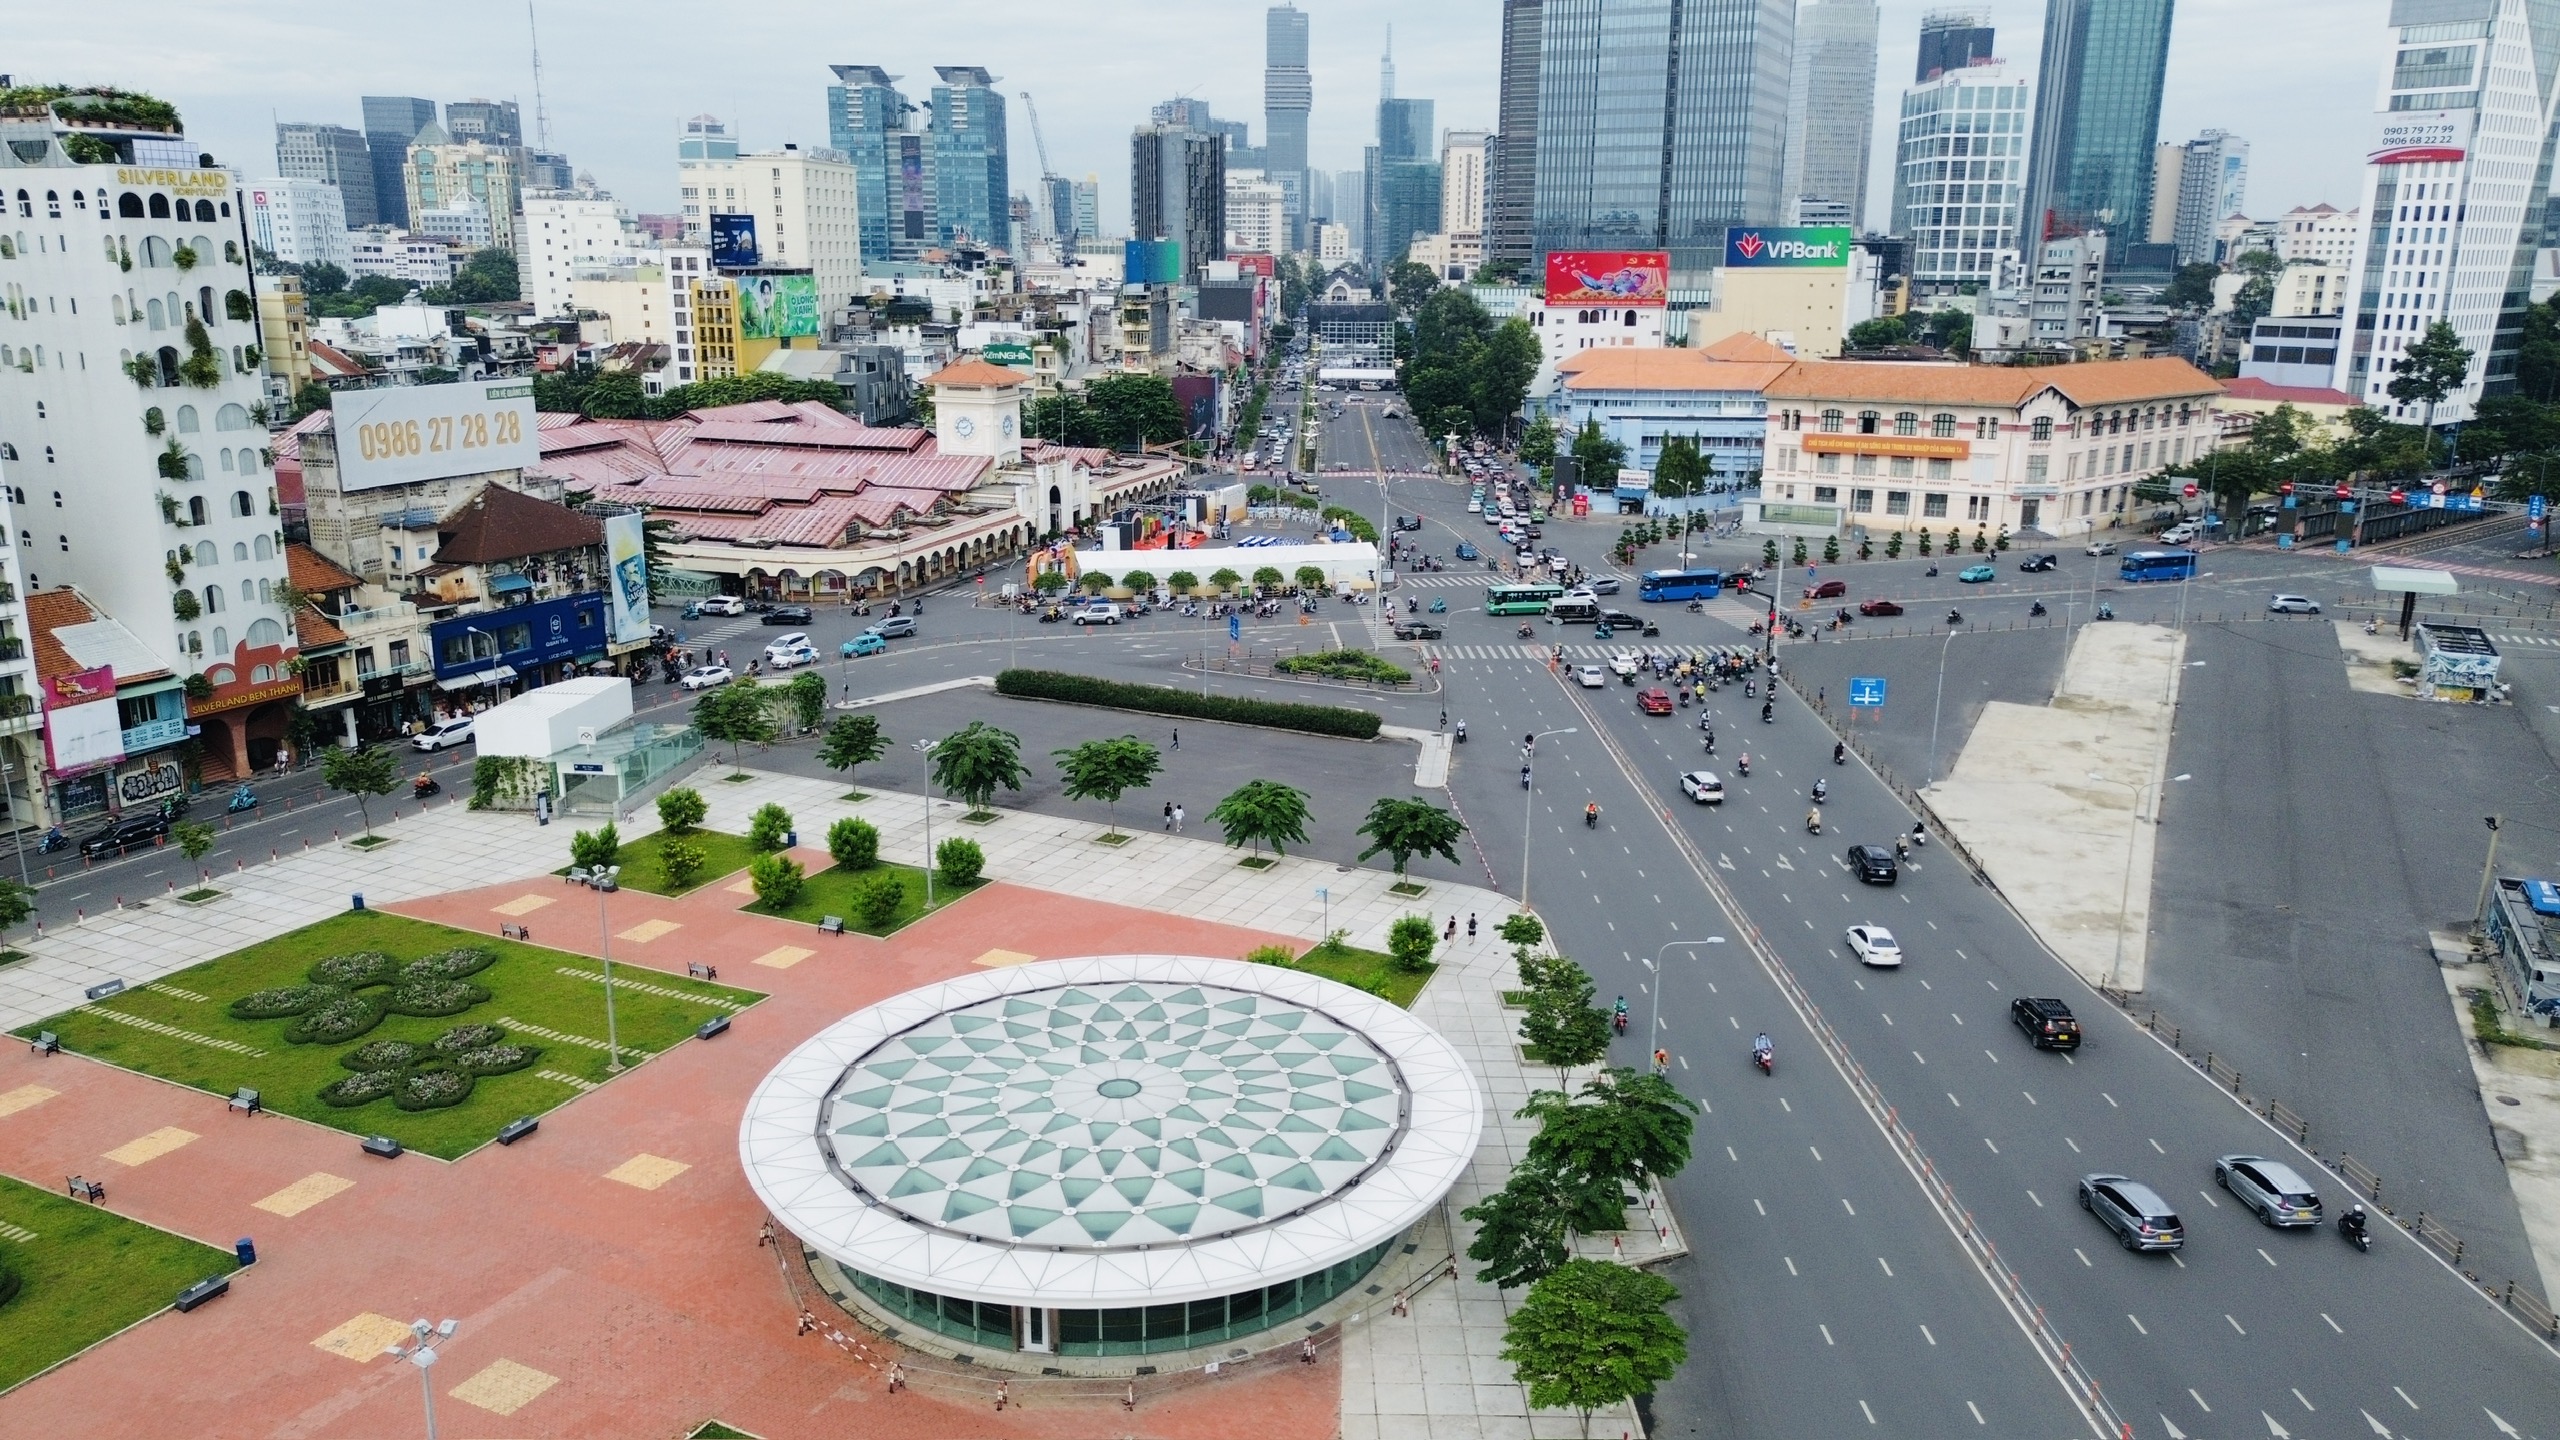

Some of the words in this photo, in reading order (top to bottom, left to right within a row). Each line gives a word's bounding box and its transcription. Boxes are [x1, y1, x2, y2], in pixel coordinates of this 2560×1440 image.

[2384, 127, 2409, 135] 0903
[2411, 126, 2424, 134] 79
[2426, 125, 2439, 134] 77
[2441, 125, 2454, 133] 99
[2382, 137, 2407, 145] 0906
[2409, 136, 2422, 144] 68
[2424, 136, 2437, 144] 22
[2439, 135, 2452, 143] 22
[117, 168, 227, 187] SILVERLAND
[173, 187, 227, 197] HOSPITALITY
[1766, 240, 1839, 259] VPBank
[793, 305, 813, 314] XANH
[359, 419, 421, 461] 0986
[427, 416, 453, 452] 27
[460, 413, 489, 448] 28
[494, 410, 521, 445] 28
[192, 695, 248, 714] SILVERLAND
[249, 690, 267, 702] BEN
[269, 683, 300, 697] THANH
